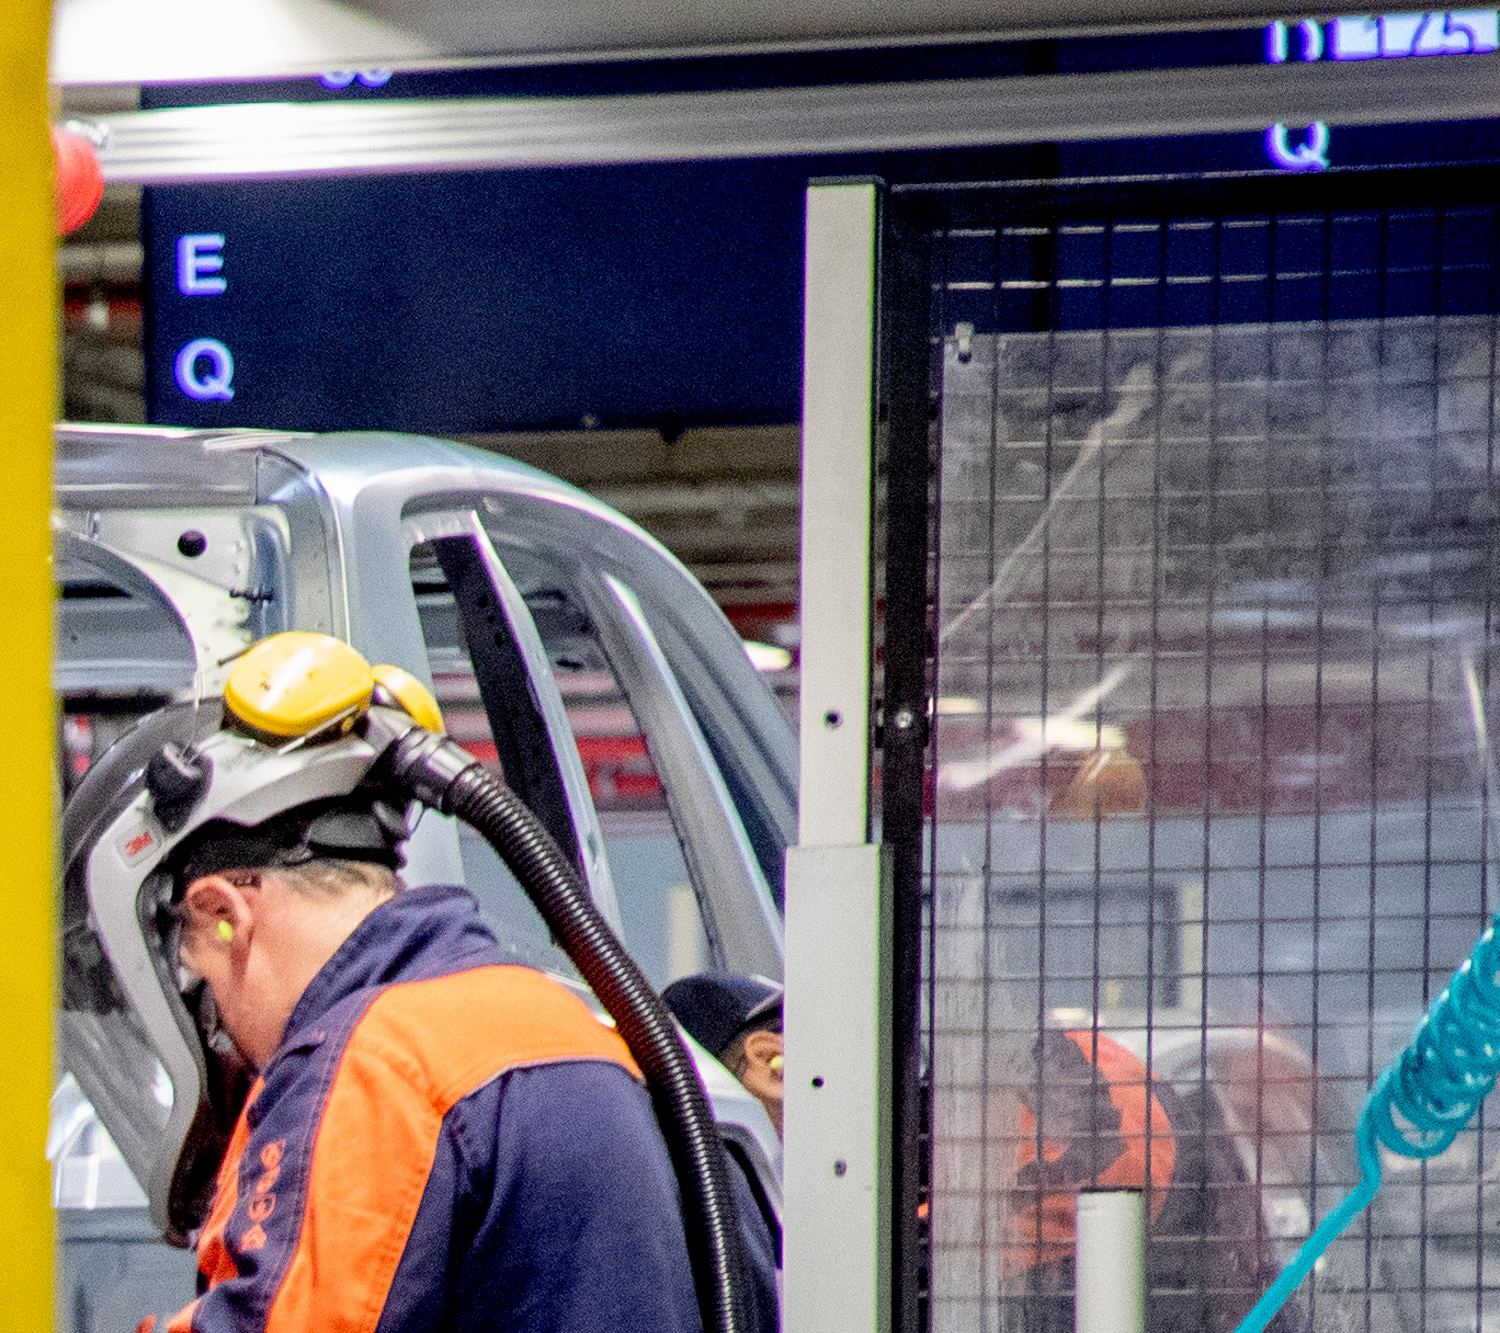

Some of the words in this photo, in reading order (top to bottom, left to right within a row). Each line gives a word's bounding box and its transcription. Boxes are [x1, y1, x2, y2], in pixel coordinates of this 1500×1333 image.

[1265, 120, 1330, 172] Q
[175, 233, 228, 297] E
[173, 338, 236, 401] Q
